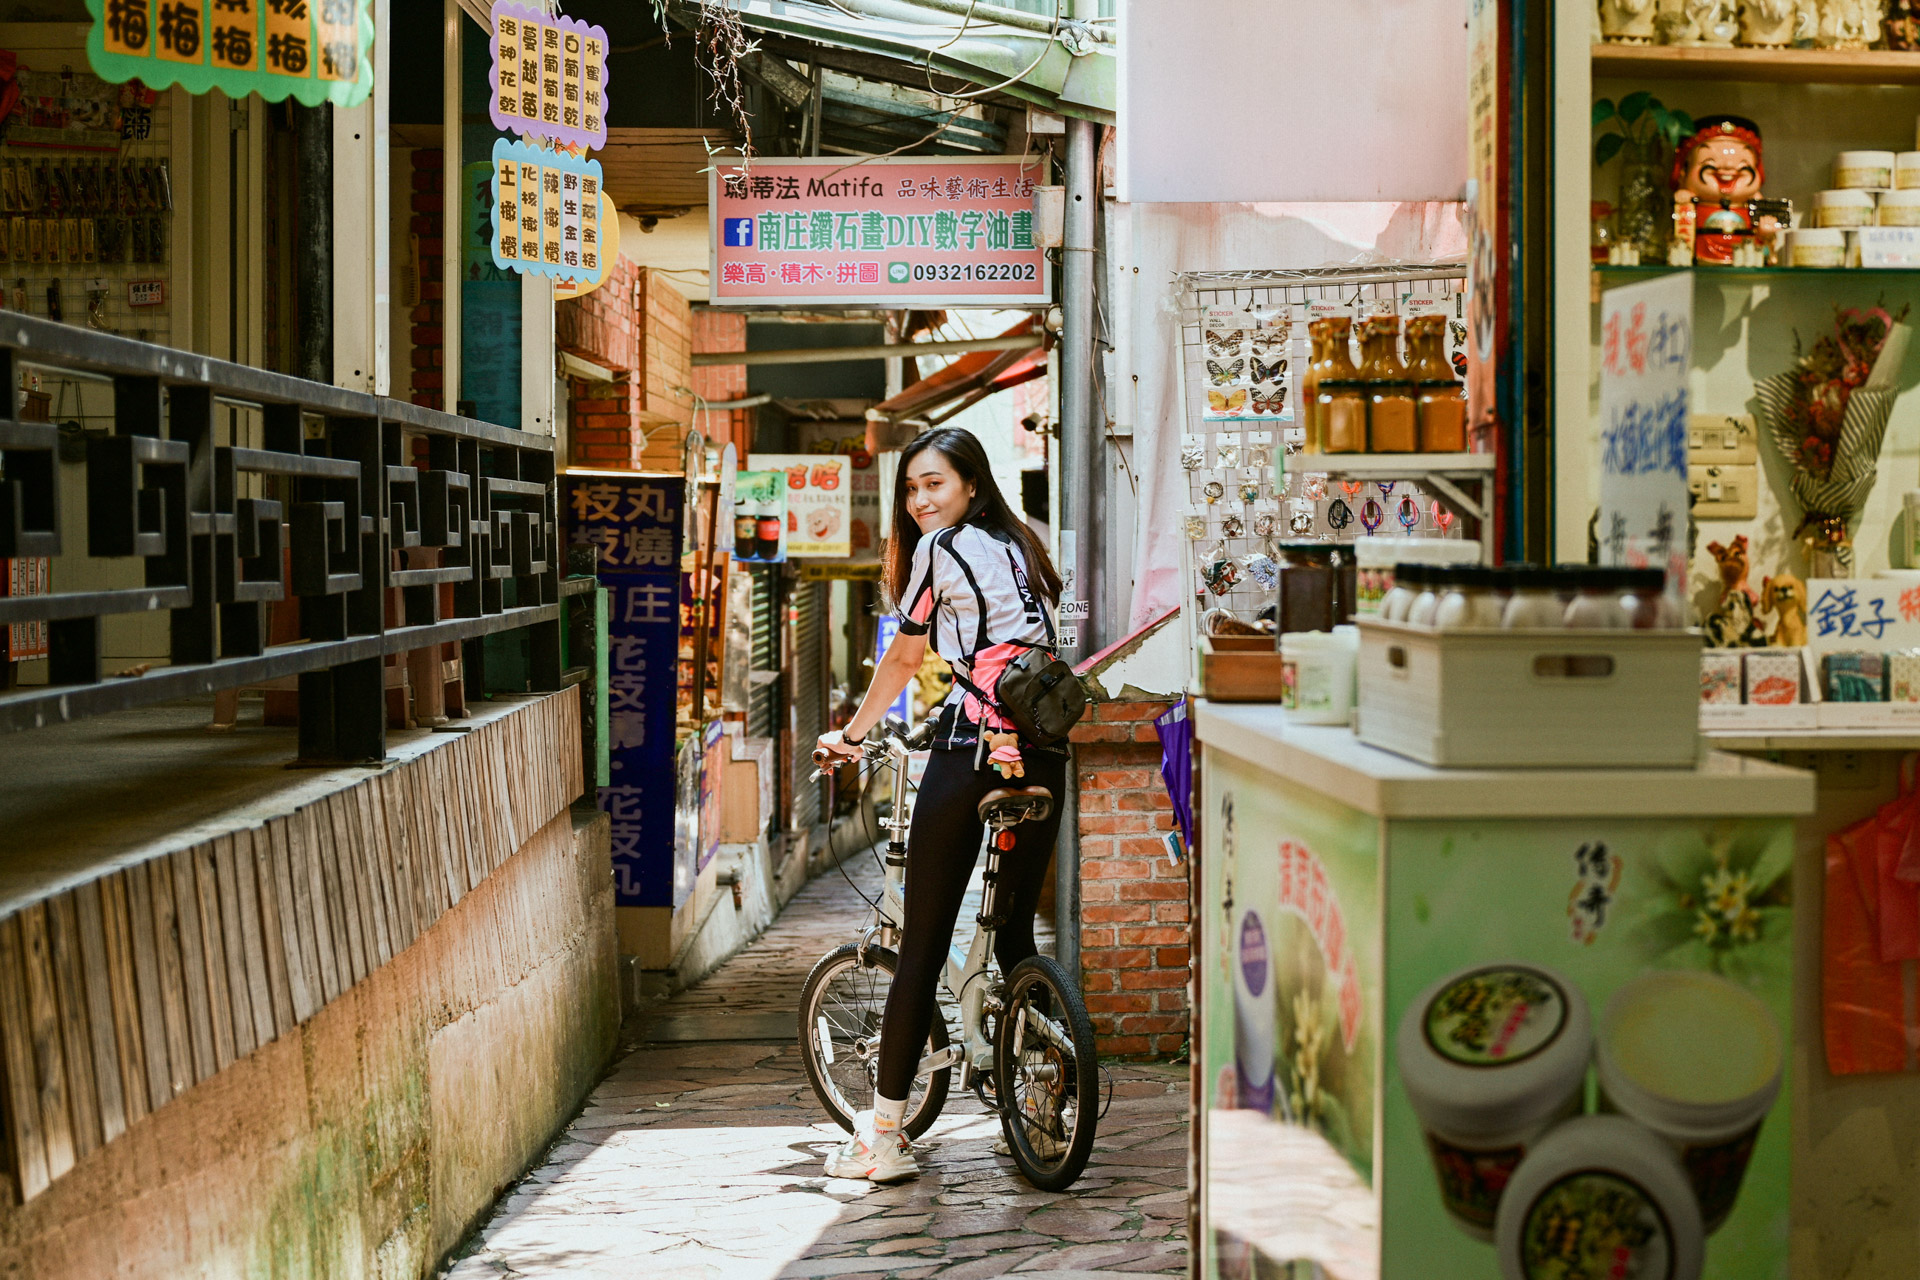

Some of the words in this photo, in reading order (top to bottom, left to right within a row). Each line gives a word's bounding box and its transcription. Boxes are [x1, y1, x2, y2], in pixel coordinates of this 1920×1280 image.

[499, 19, 517, 114] 洛神花乾
[522, 24, 538, 118] 蔓越莓
[543, 28, 559, 122] 黑葡萄乾
[563, 34, 579, 126] 白葡萄乾
[584, 40, 600, 132] 水蜜桃乾
[500, 164, 518, 258] 土橄欖
[563, 173, 578, 267] 野生金桔
[807, 176, 884, 198] Matifa
[897, 176, 1035, 200] 品味藝術生活
[913, 264, 1036, 281] 0932162202
[1811, 586, 1896, 640] 鏡子
